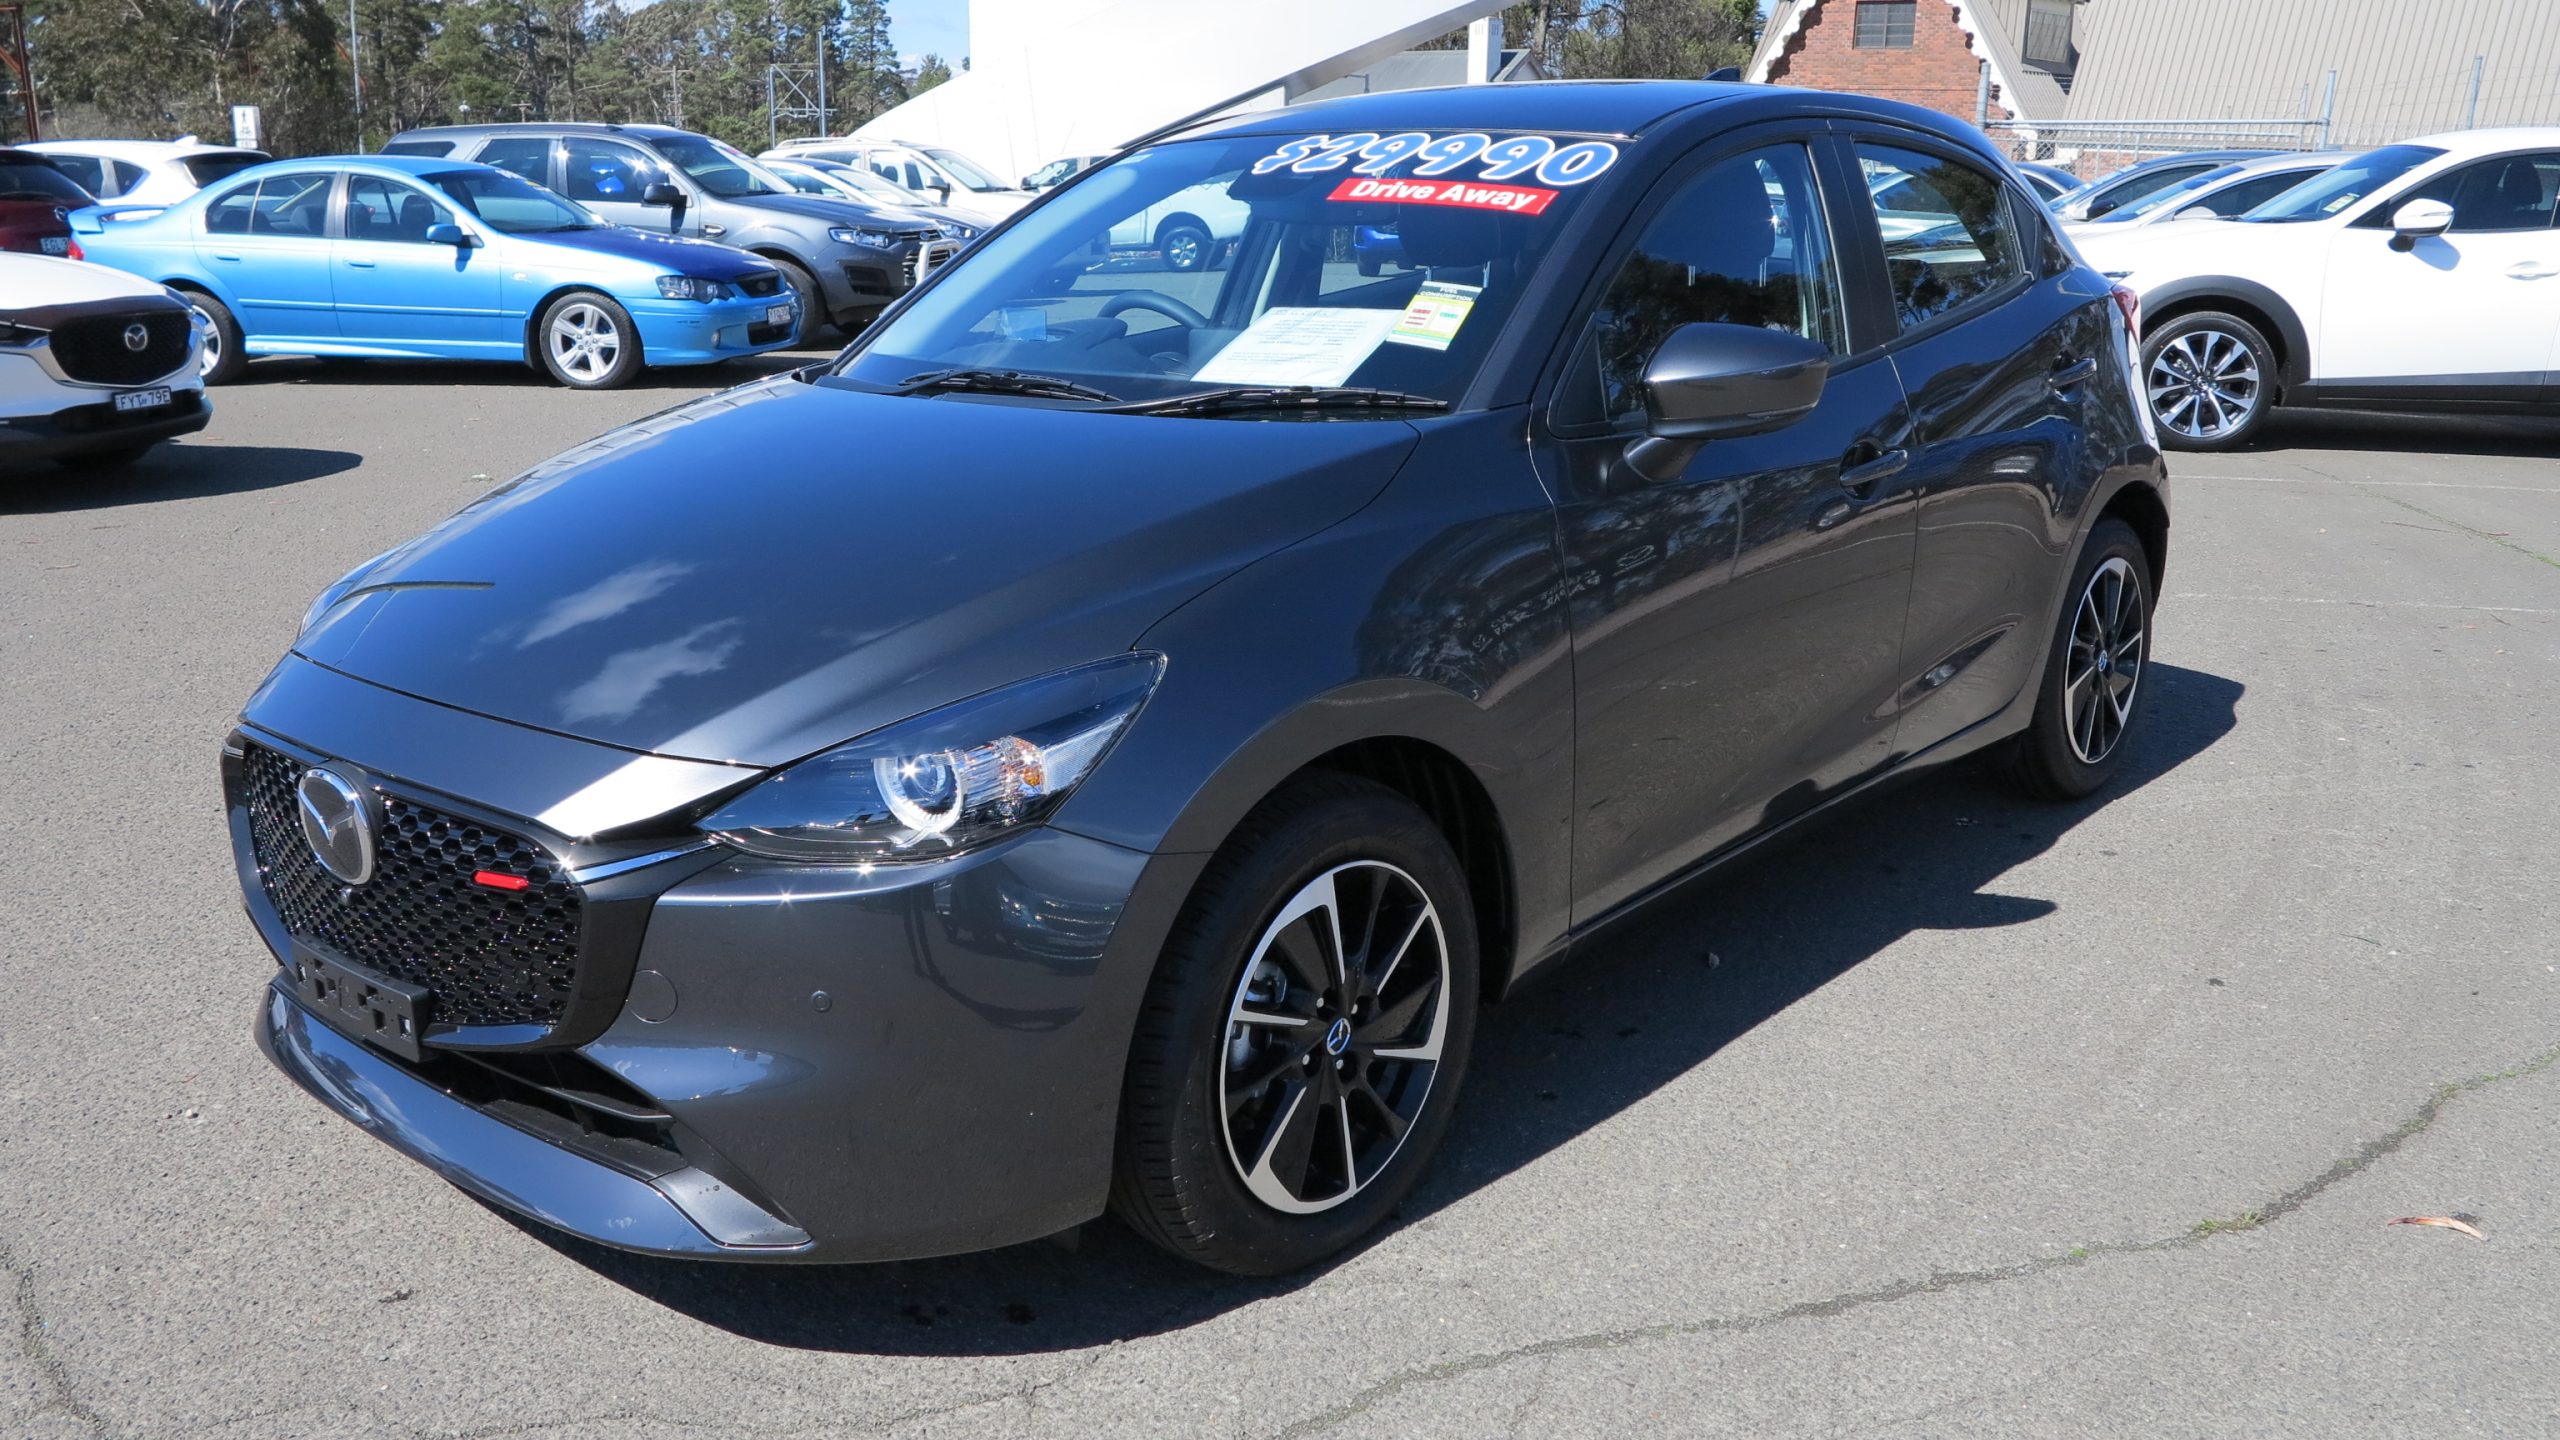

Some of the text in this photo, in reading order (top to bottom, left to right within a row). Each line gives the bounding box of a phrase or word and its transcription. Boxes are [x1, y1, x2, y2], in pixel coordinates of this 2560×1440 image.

[1251, 132, 1618, 186] $29990
[1349, 180, 1538, 211] Drive Away
[1420, 290, 1474, 302] CONSUMPTION
